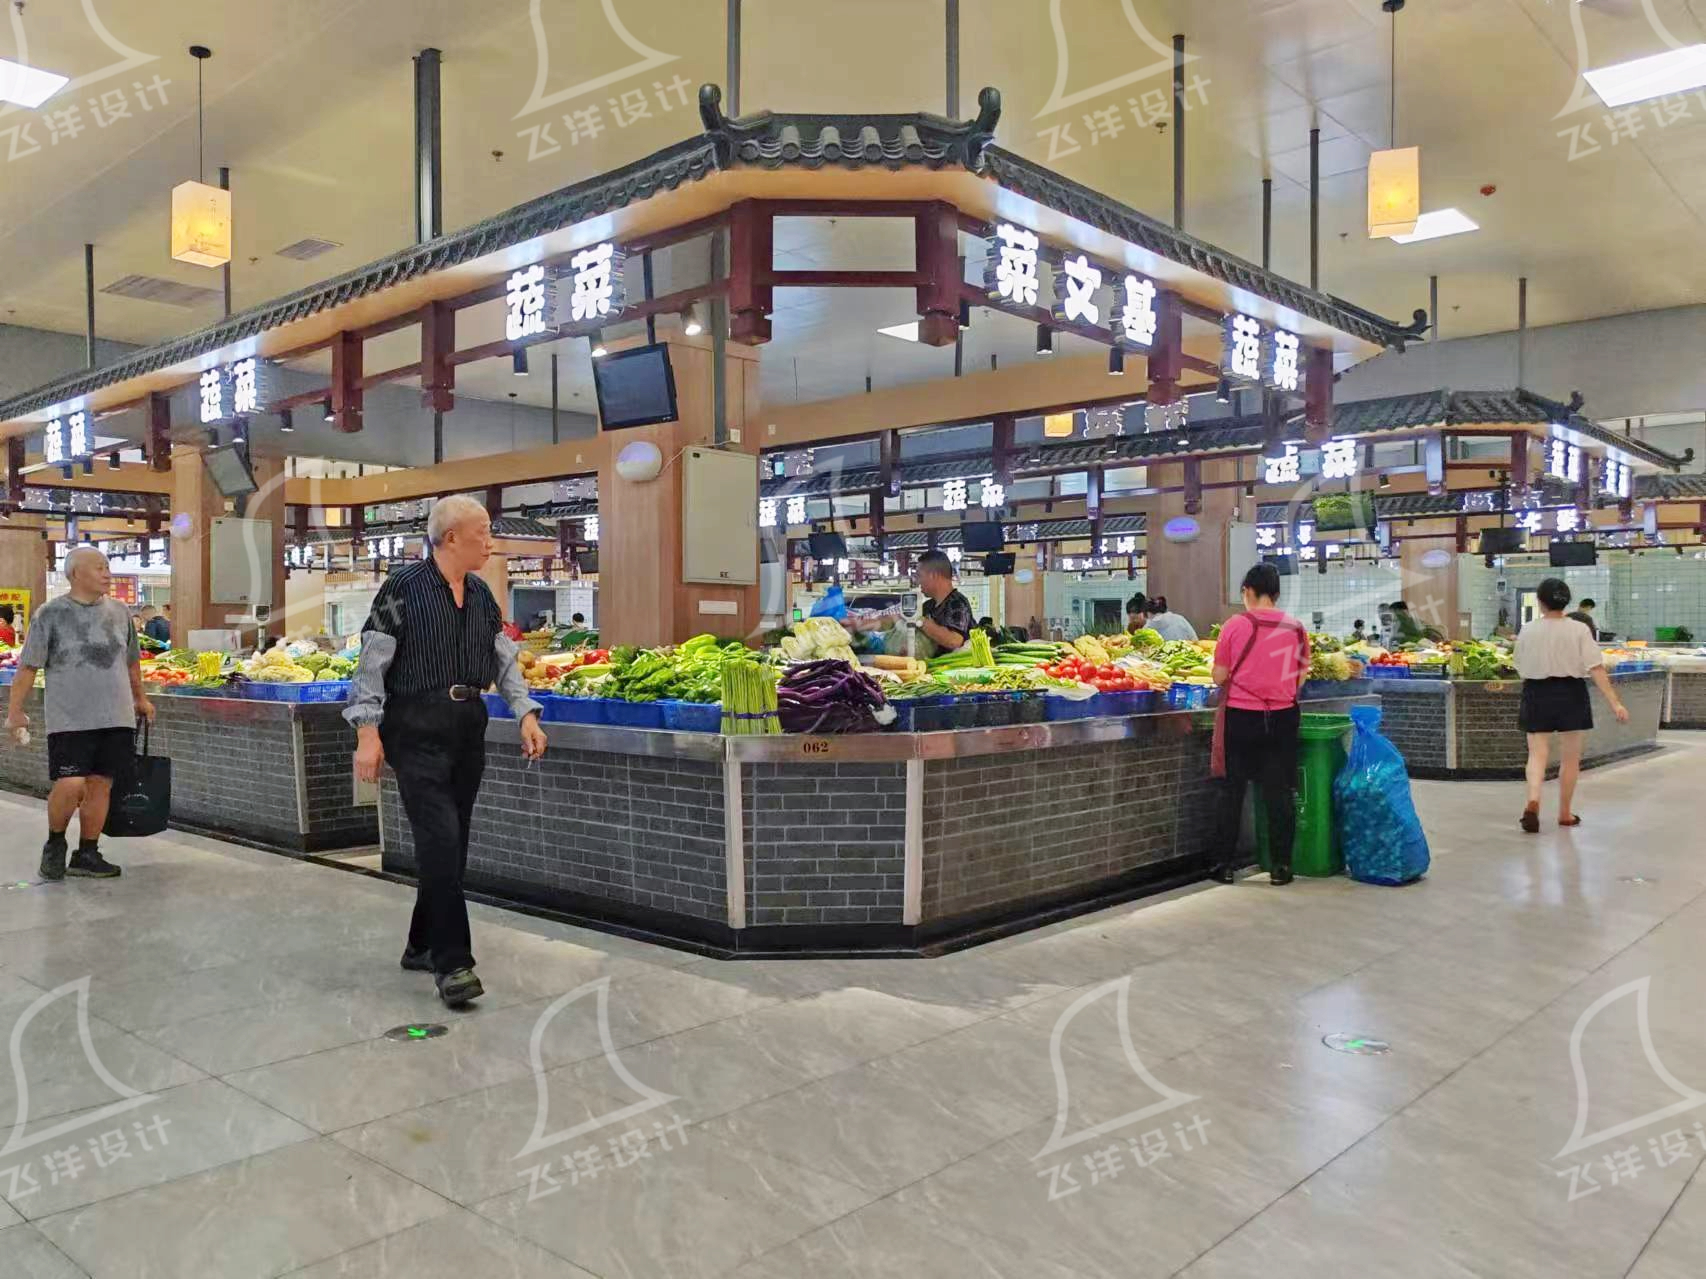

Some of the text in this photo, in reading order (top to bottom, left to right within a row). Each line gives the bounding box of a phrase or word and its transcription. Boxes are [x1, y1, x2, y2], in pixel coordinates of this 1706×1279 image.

[506, 244, 613, 340] 蔬菜
[1231, 314, 1299, 391] 蔬菜
[200, 358, 257, 423] 蔬菜
[1265, 440, 1358, 483] 蔬菜
[943, 478, 1005, 511] 蔬菜
[803, 741, 829, 753] 062
